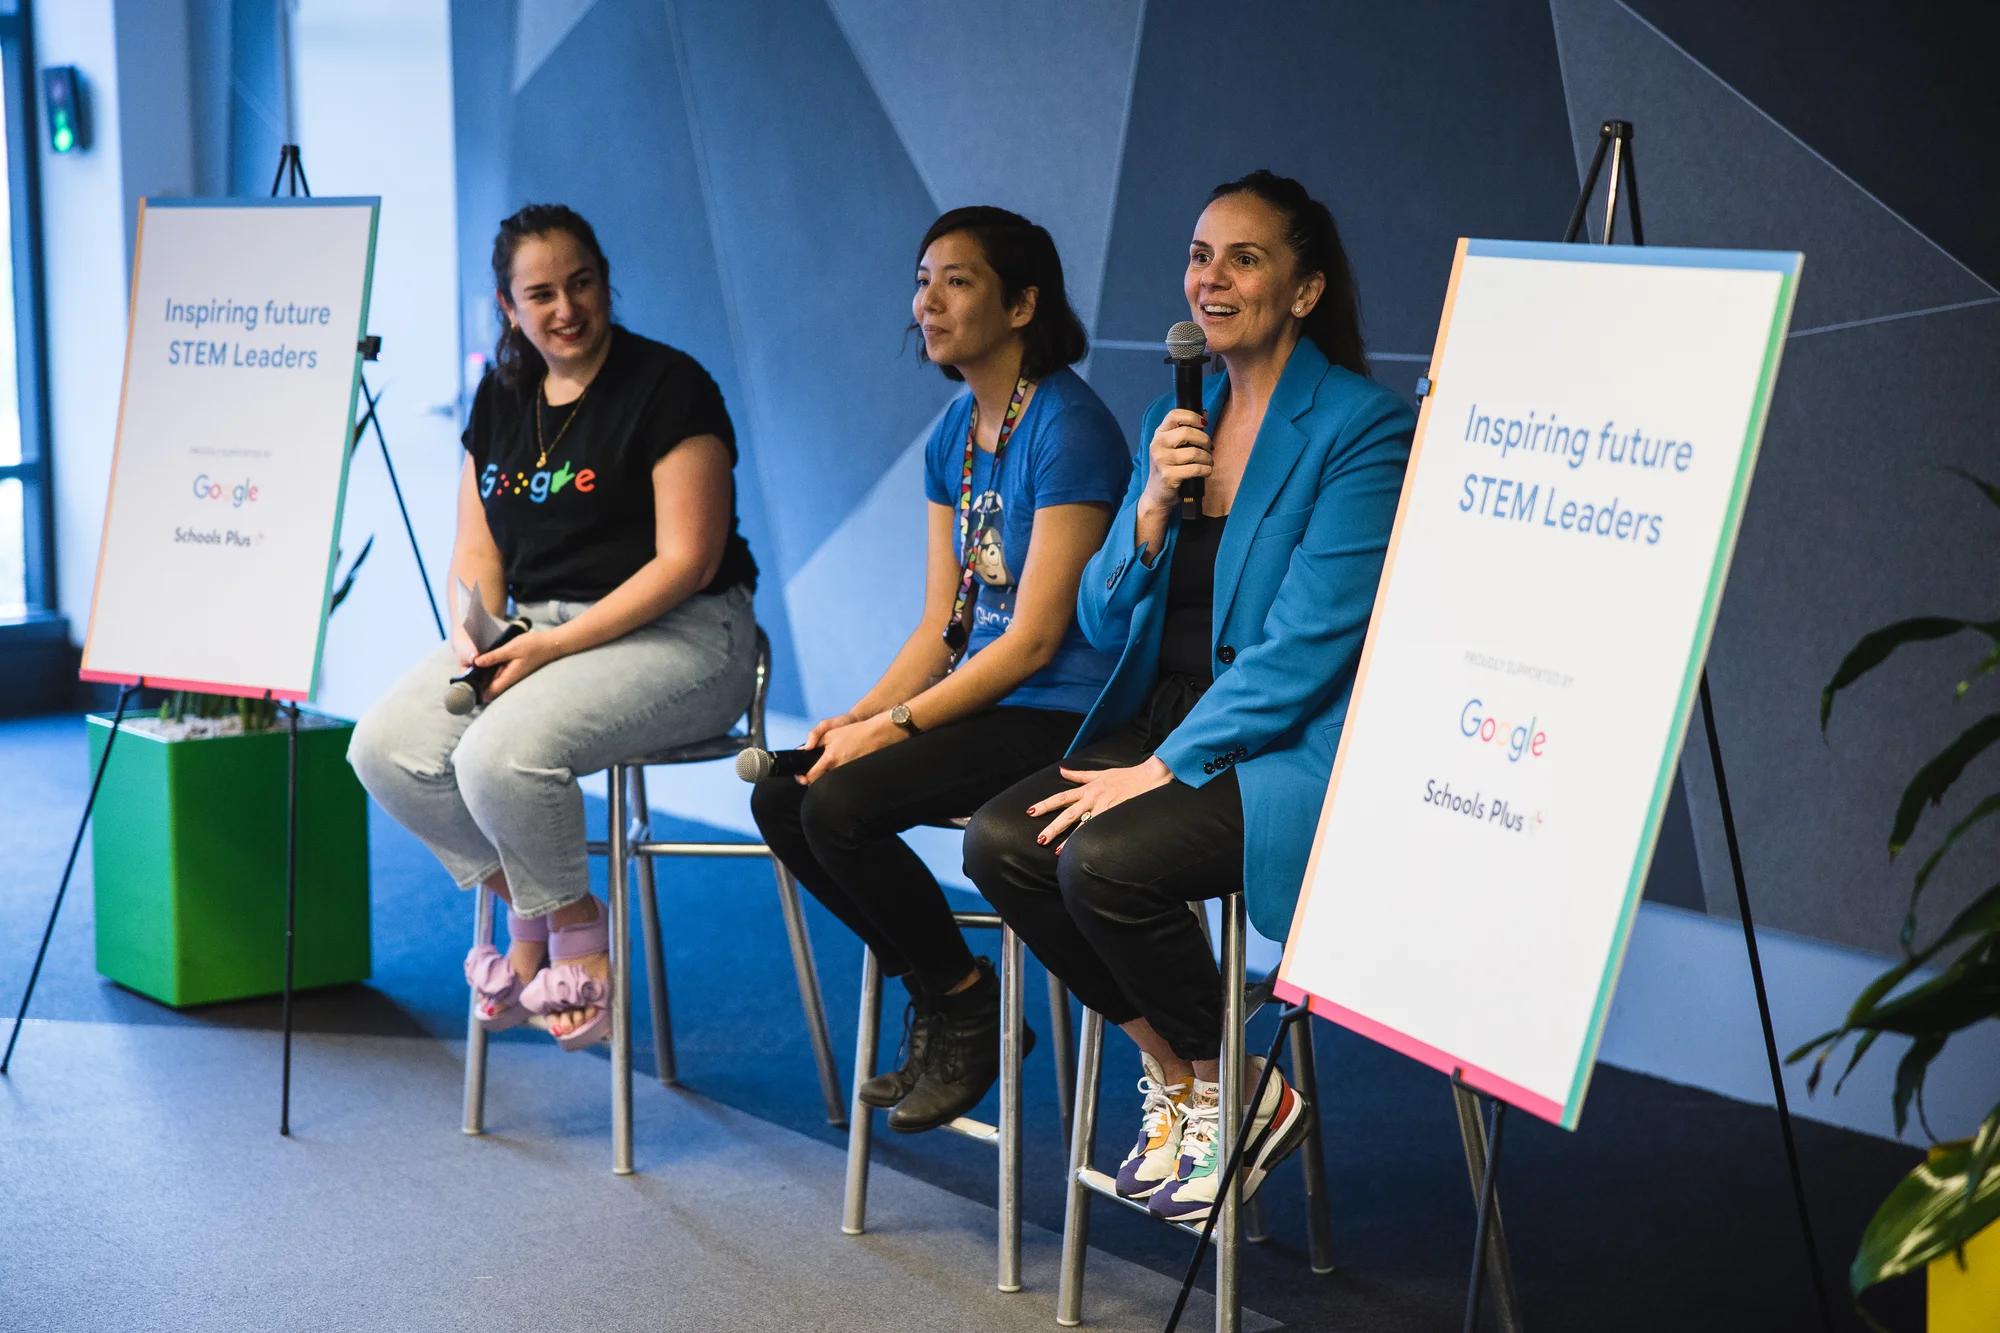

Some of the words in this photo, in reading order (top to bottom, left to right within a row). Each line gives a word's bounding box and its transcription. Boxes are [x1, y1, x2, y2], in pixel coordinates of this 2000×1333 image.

[165, 297, 259, 331] Inspiring
[264, 299, 331, 325] future
[168, 339, 228, 367] STEM
[233, 342, 318, 369] Leaders
[1464, 404, 1590, 469] Inspiring
[1596, 420, 1694, 473] future
[192, 473, 259, 508] Google
[1459, 473, 1540, 523] STEM
[1543, 487, 1664, 546] Leaders
[174, 526, 221, 545] Schools
[225, 529, 251, 548] Plus
[1460, 698, 1547, 763] Google
[1423, 778, 1485, 820] Schools
[1489, 799, 1525, 832] Plus
